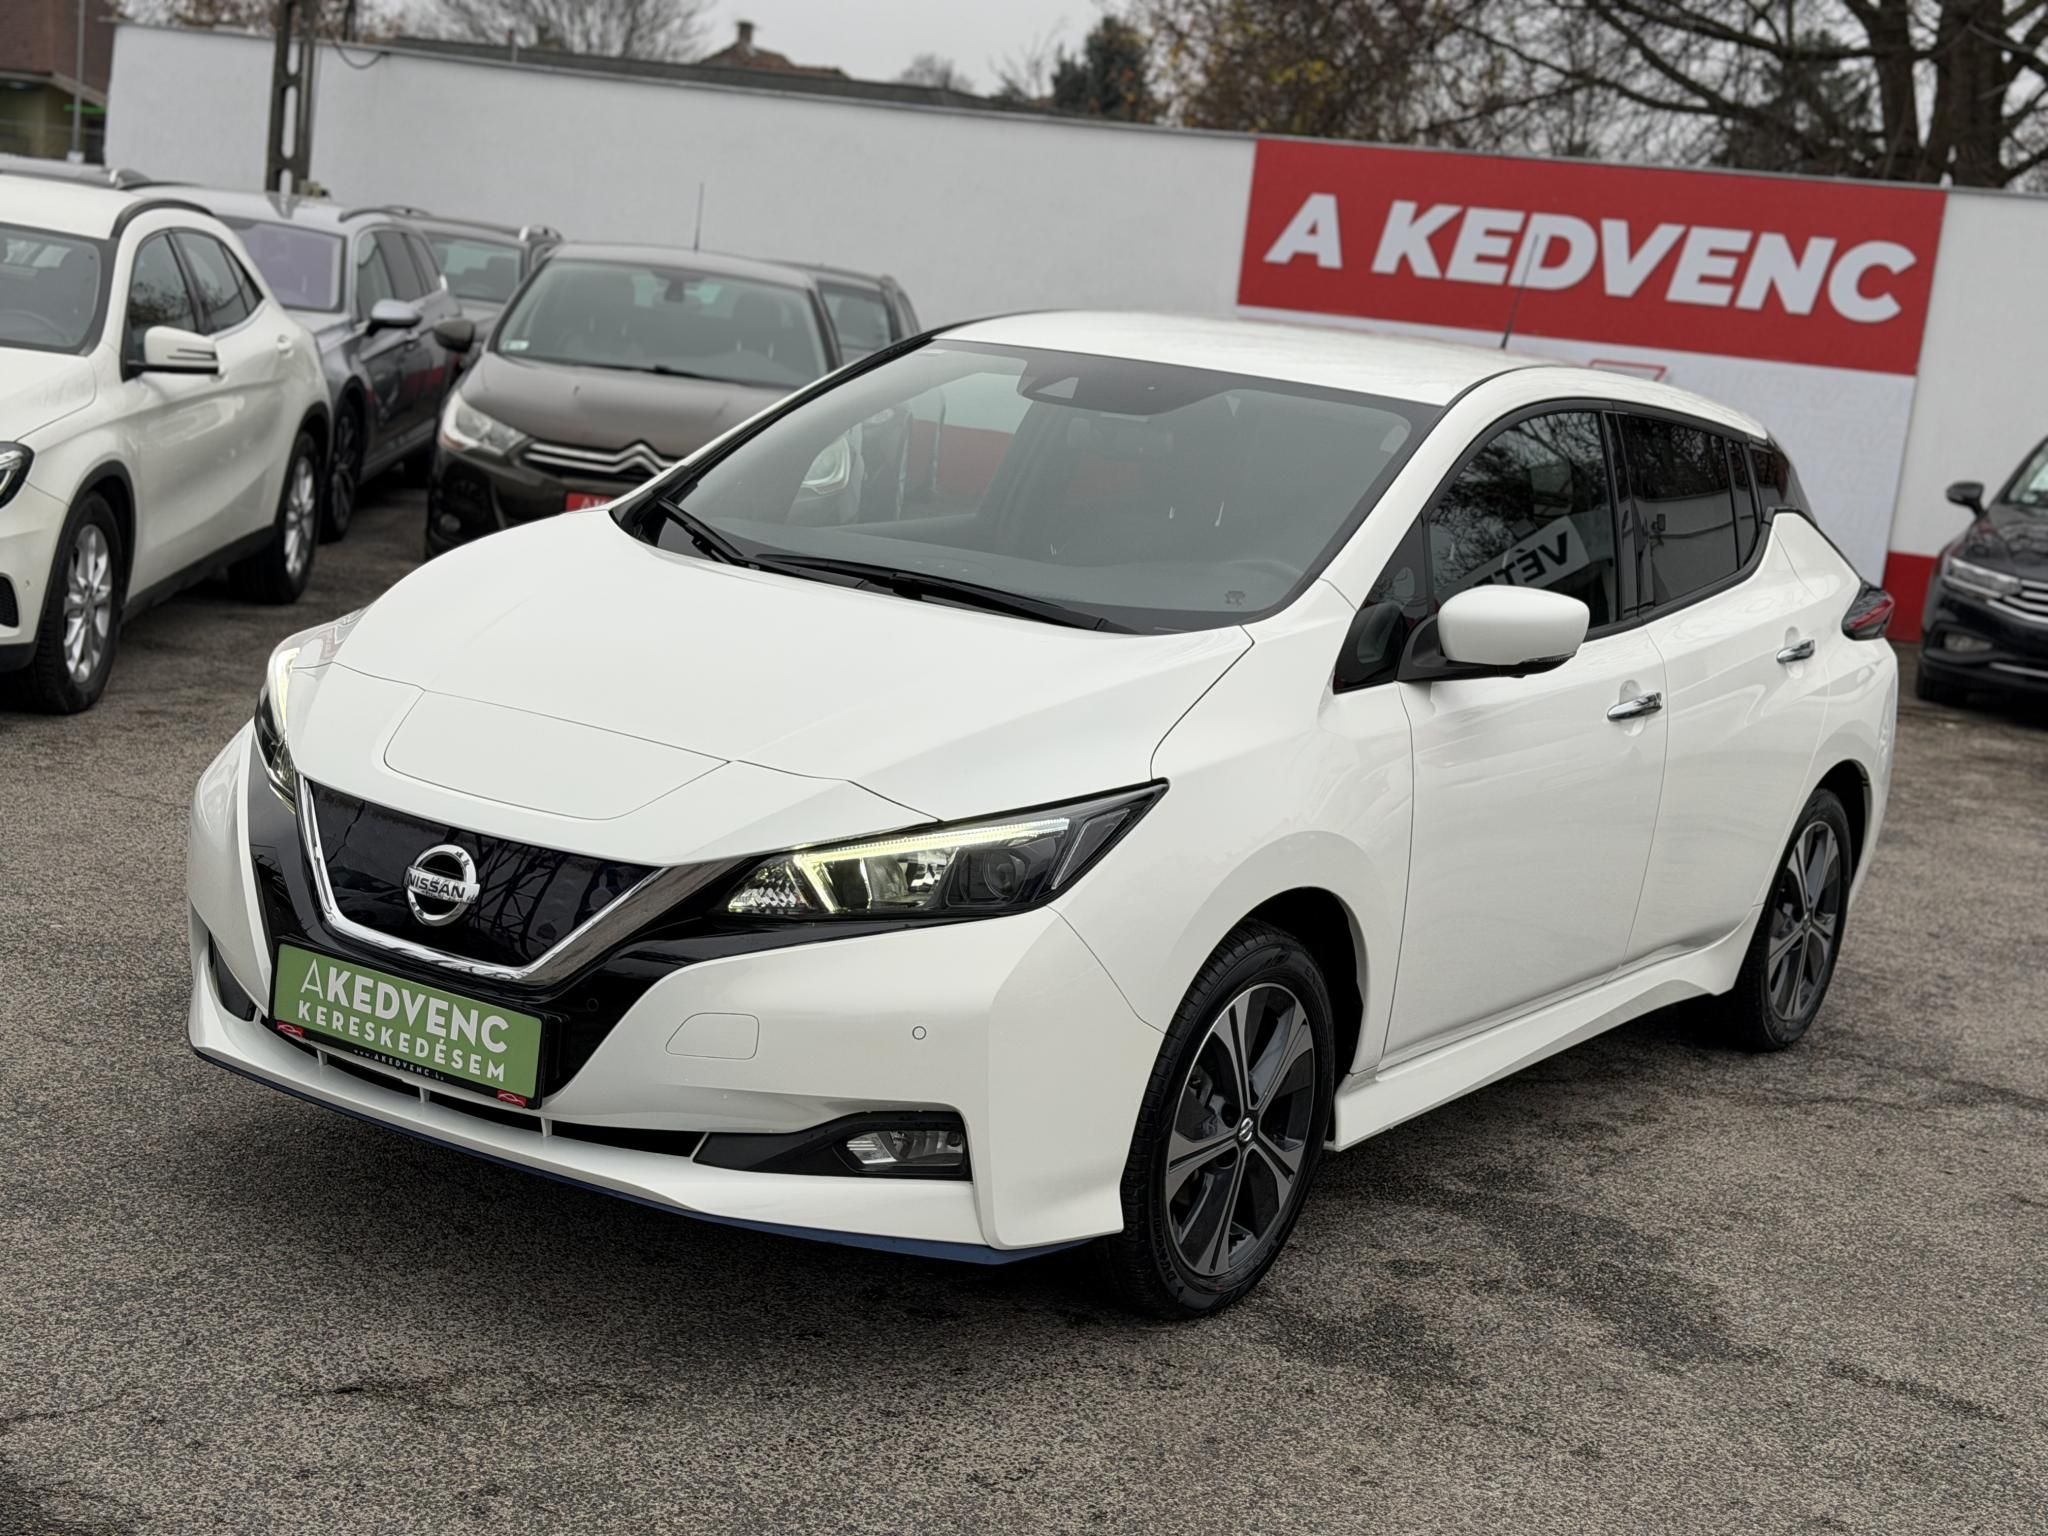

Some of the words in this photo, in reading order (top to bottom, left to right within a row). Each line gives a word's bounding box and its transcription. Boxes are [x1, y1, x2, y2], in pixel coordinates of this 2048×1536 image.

[1264, 193, 1343, 269] A
[1371, 200, 1917, 323] KEDVENC
[408, 873, 466, 898] NISSAN
[297, 1000, 505, 1082] KERESKEDÉSEM
